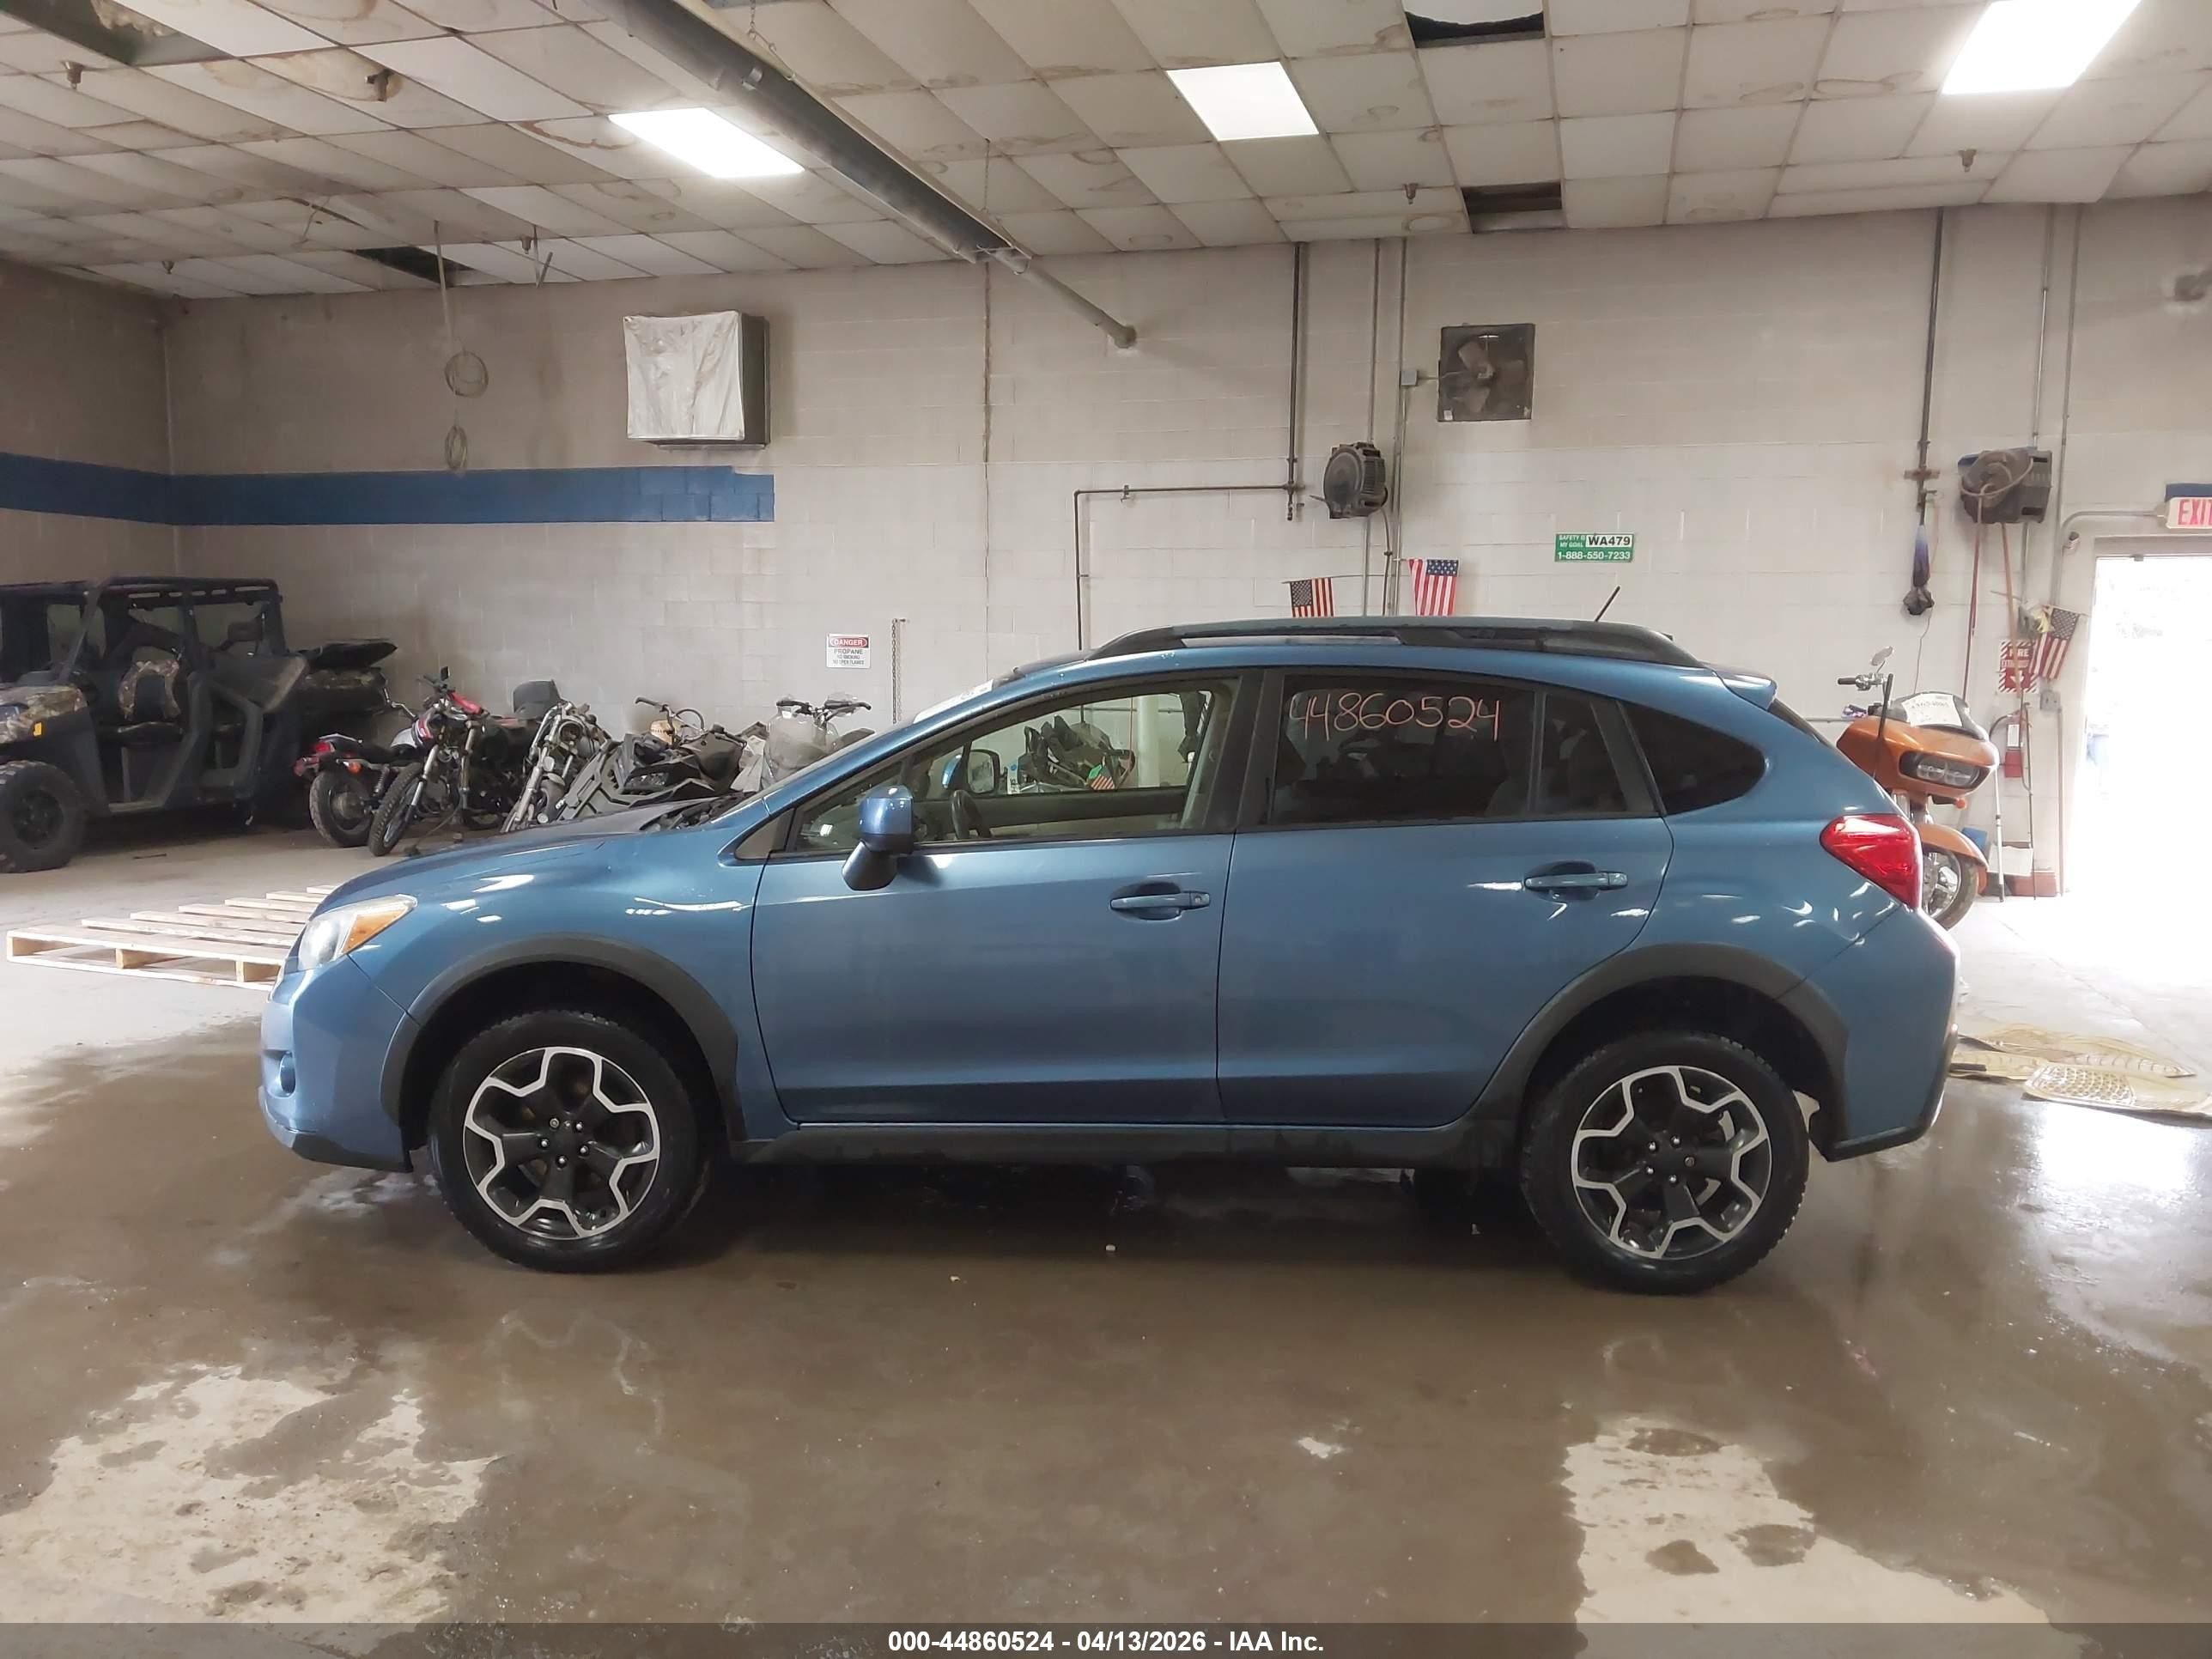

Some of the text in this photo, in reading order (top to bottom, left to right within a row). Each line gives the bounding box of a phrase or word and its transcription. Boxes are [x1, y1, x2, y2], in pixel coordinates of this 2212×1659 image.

[1588, 536, 1631, 546] WA479
[1558, 551, 1631, 560] 1-888-550-7233
[1289, 692, 1500, 742] 44860524
